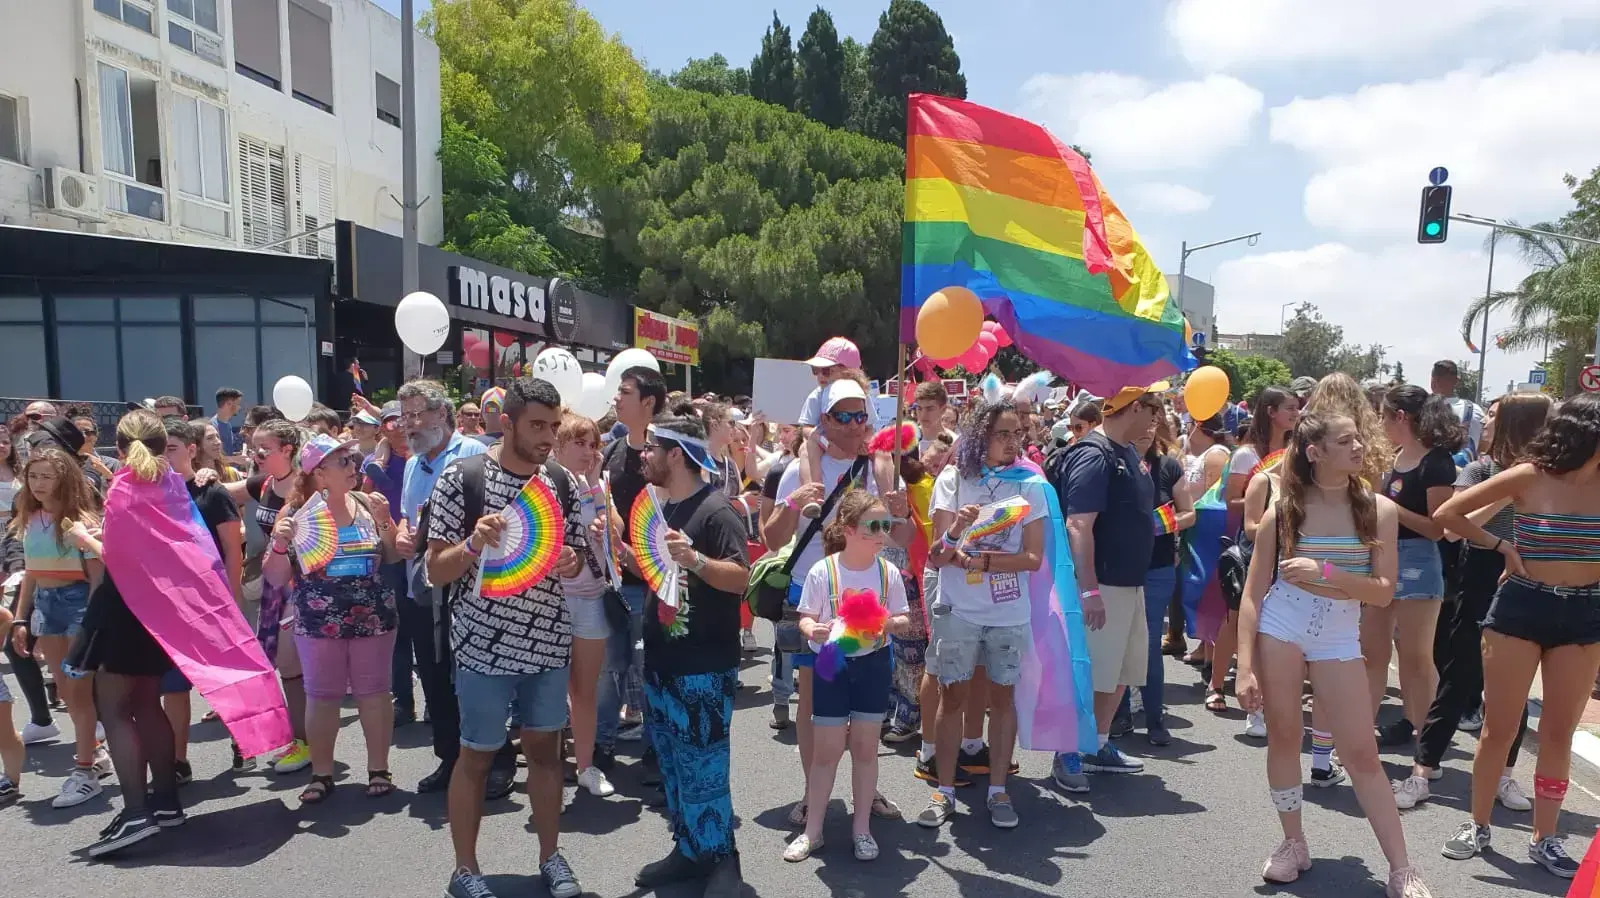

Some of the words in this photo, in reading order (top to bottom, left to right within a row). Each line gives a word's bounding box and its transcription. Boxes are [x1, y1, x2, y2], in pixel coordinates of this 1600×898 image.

[459, 266, 546, 324] masa
[490, 603, 532, 624] HOPES
[533, 616, 553, 630] OR
[498, 595, 559, 619] TAINTIES
[500, 632, 534, 650] HIGH
[528, 627, 559, 643] HIGH
[462, 643, 495, 663] HIGH
[469, 635, 491, 650] OR
[491, 643, 566, 668] CERTAINTIES
